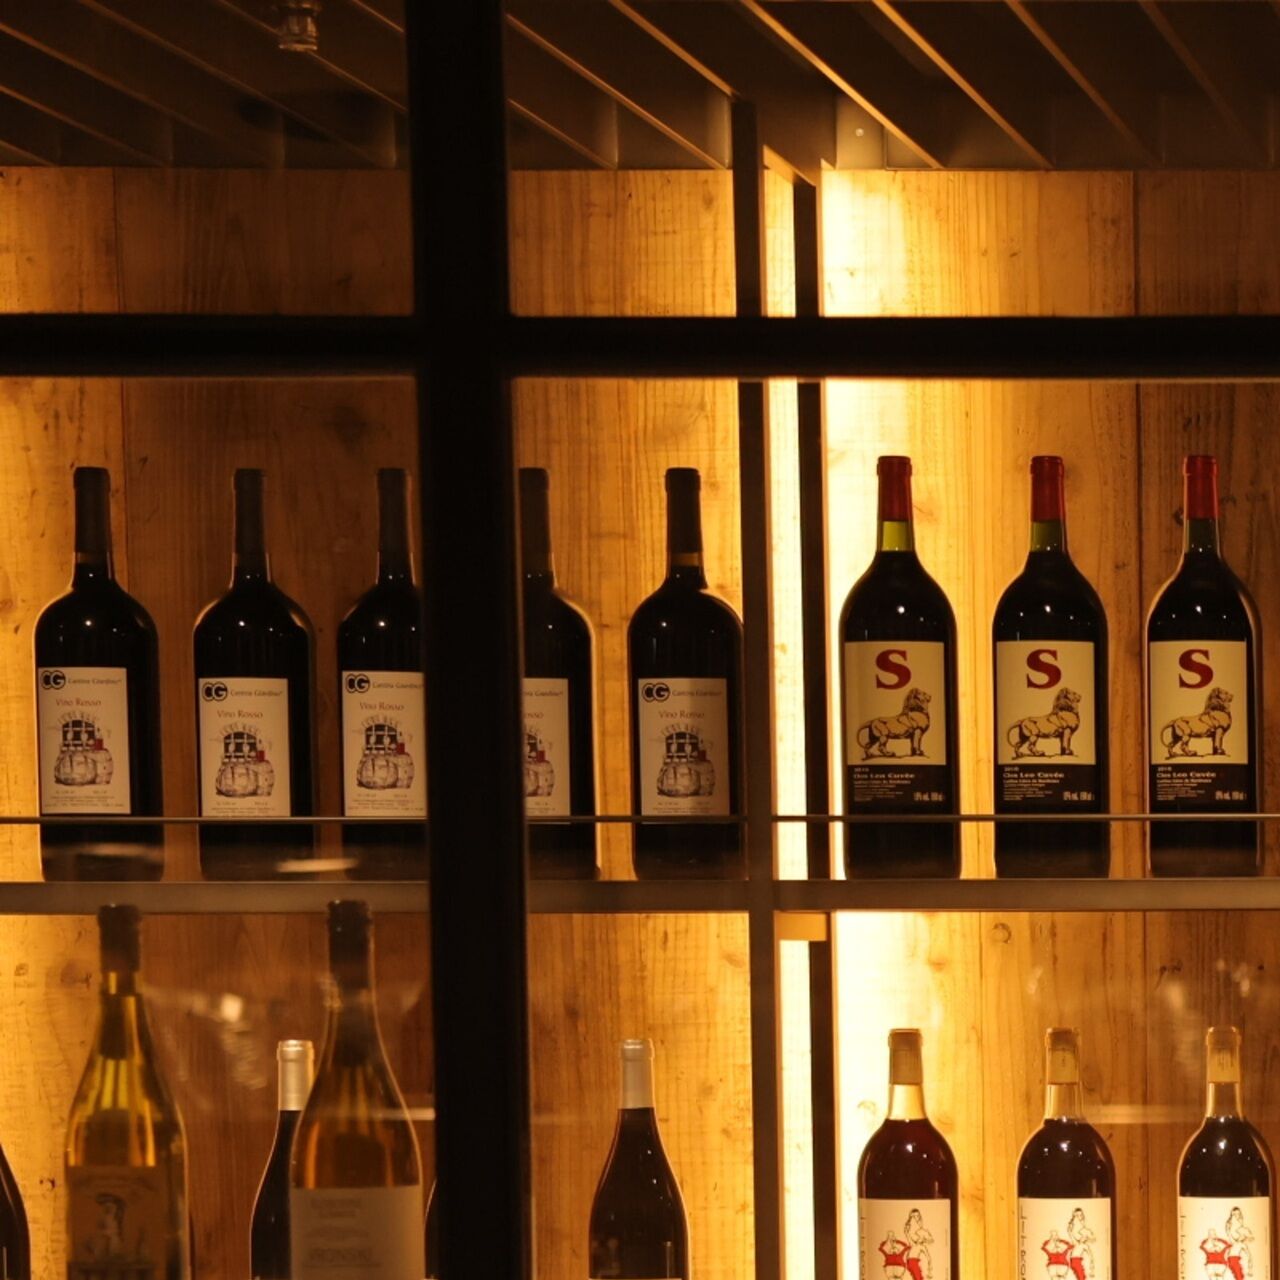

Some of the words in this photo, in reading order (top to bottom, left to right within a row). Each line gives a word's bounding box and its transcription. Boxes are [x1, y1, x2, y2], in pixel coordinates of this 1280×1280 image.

[875, 648, 912, 690] S
[1026, 648, 1062, 689] S
[1178, 648, 1214, 689] S
